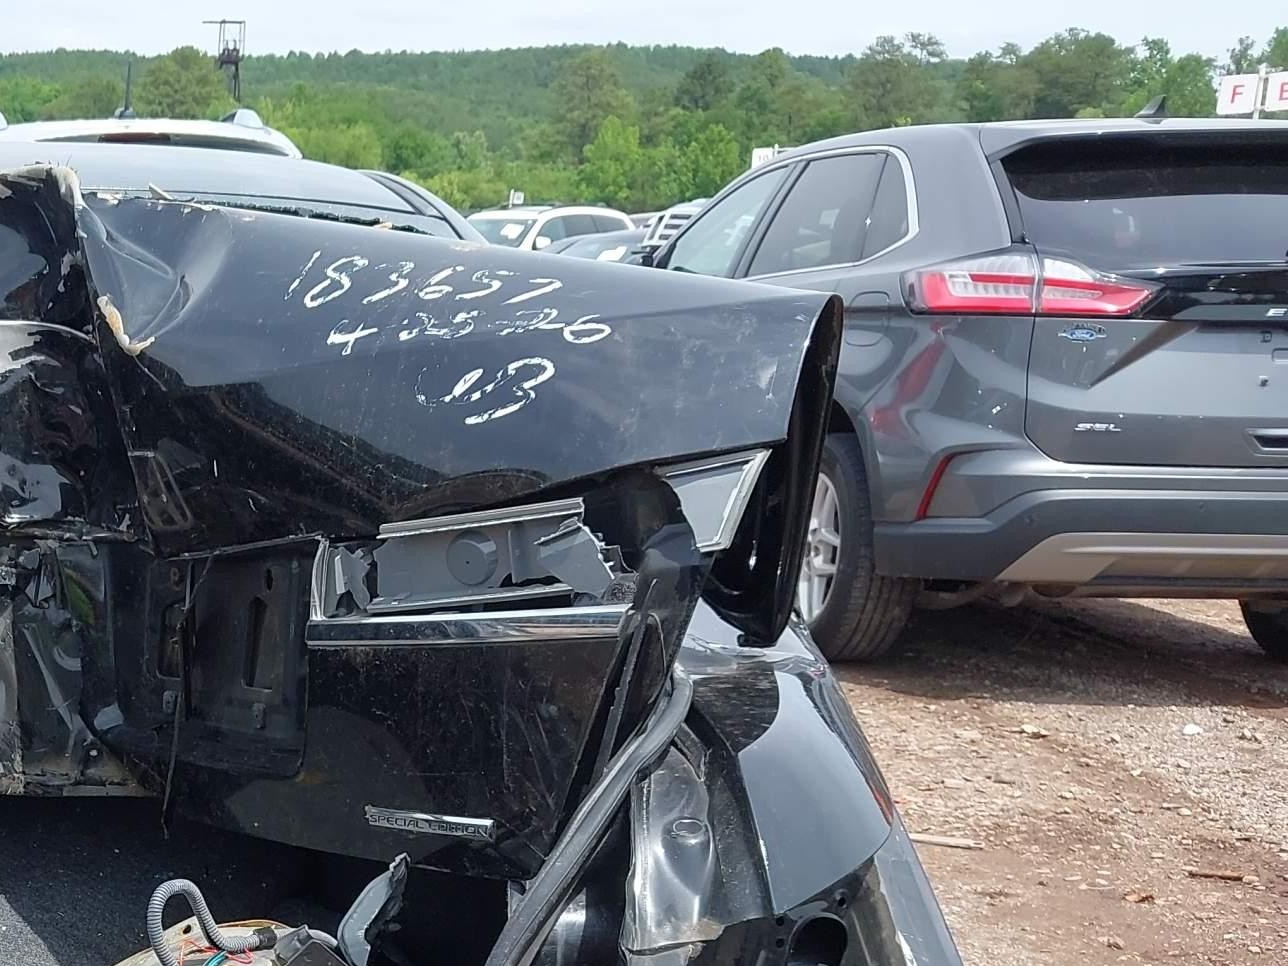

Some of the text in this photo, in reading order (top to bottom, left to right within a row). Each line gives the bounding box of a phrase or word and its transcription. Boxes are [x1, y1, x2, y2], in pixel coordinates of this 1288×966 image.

[1230, 84, 1245, 104] F
[1073, 423, 1122, 433] SEL
[368, 814, 489, 837] SPECIAL EDITION
